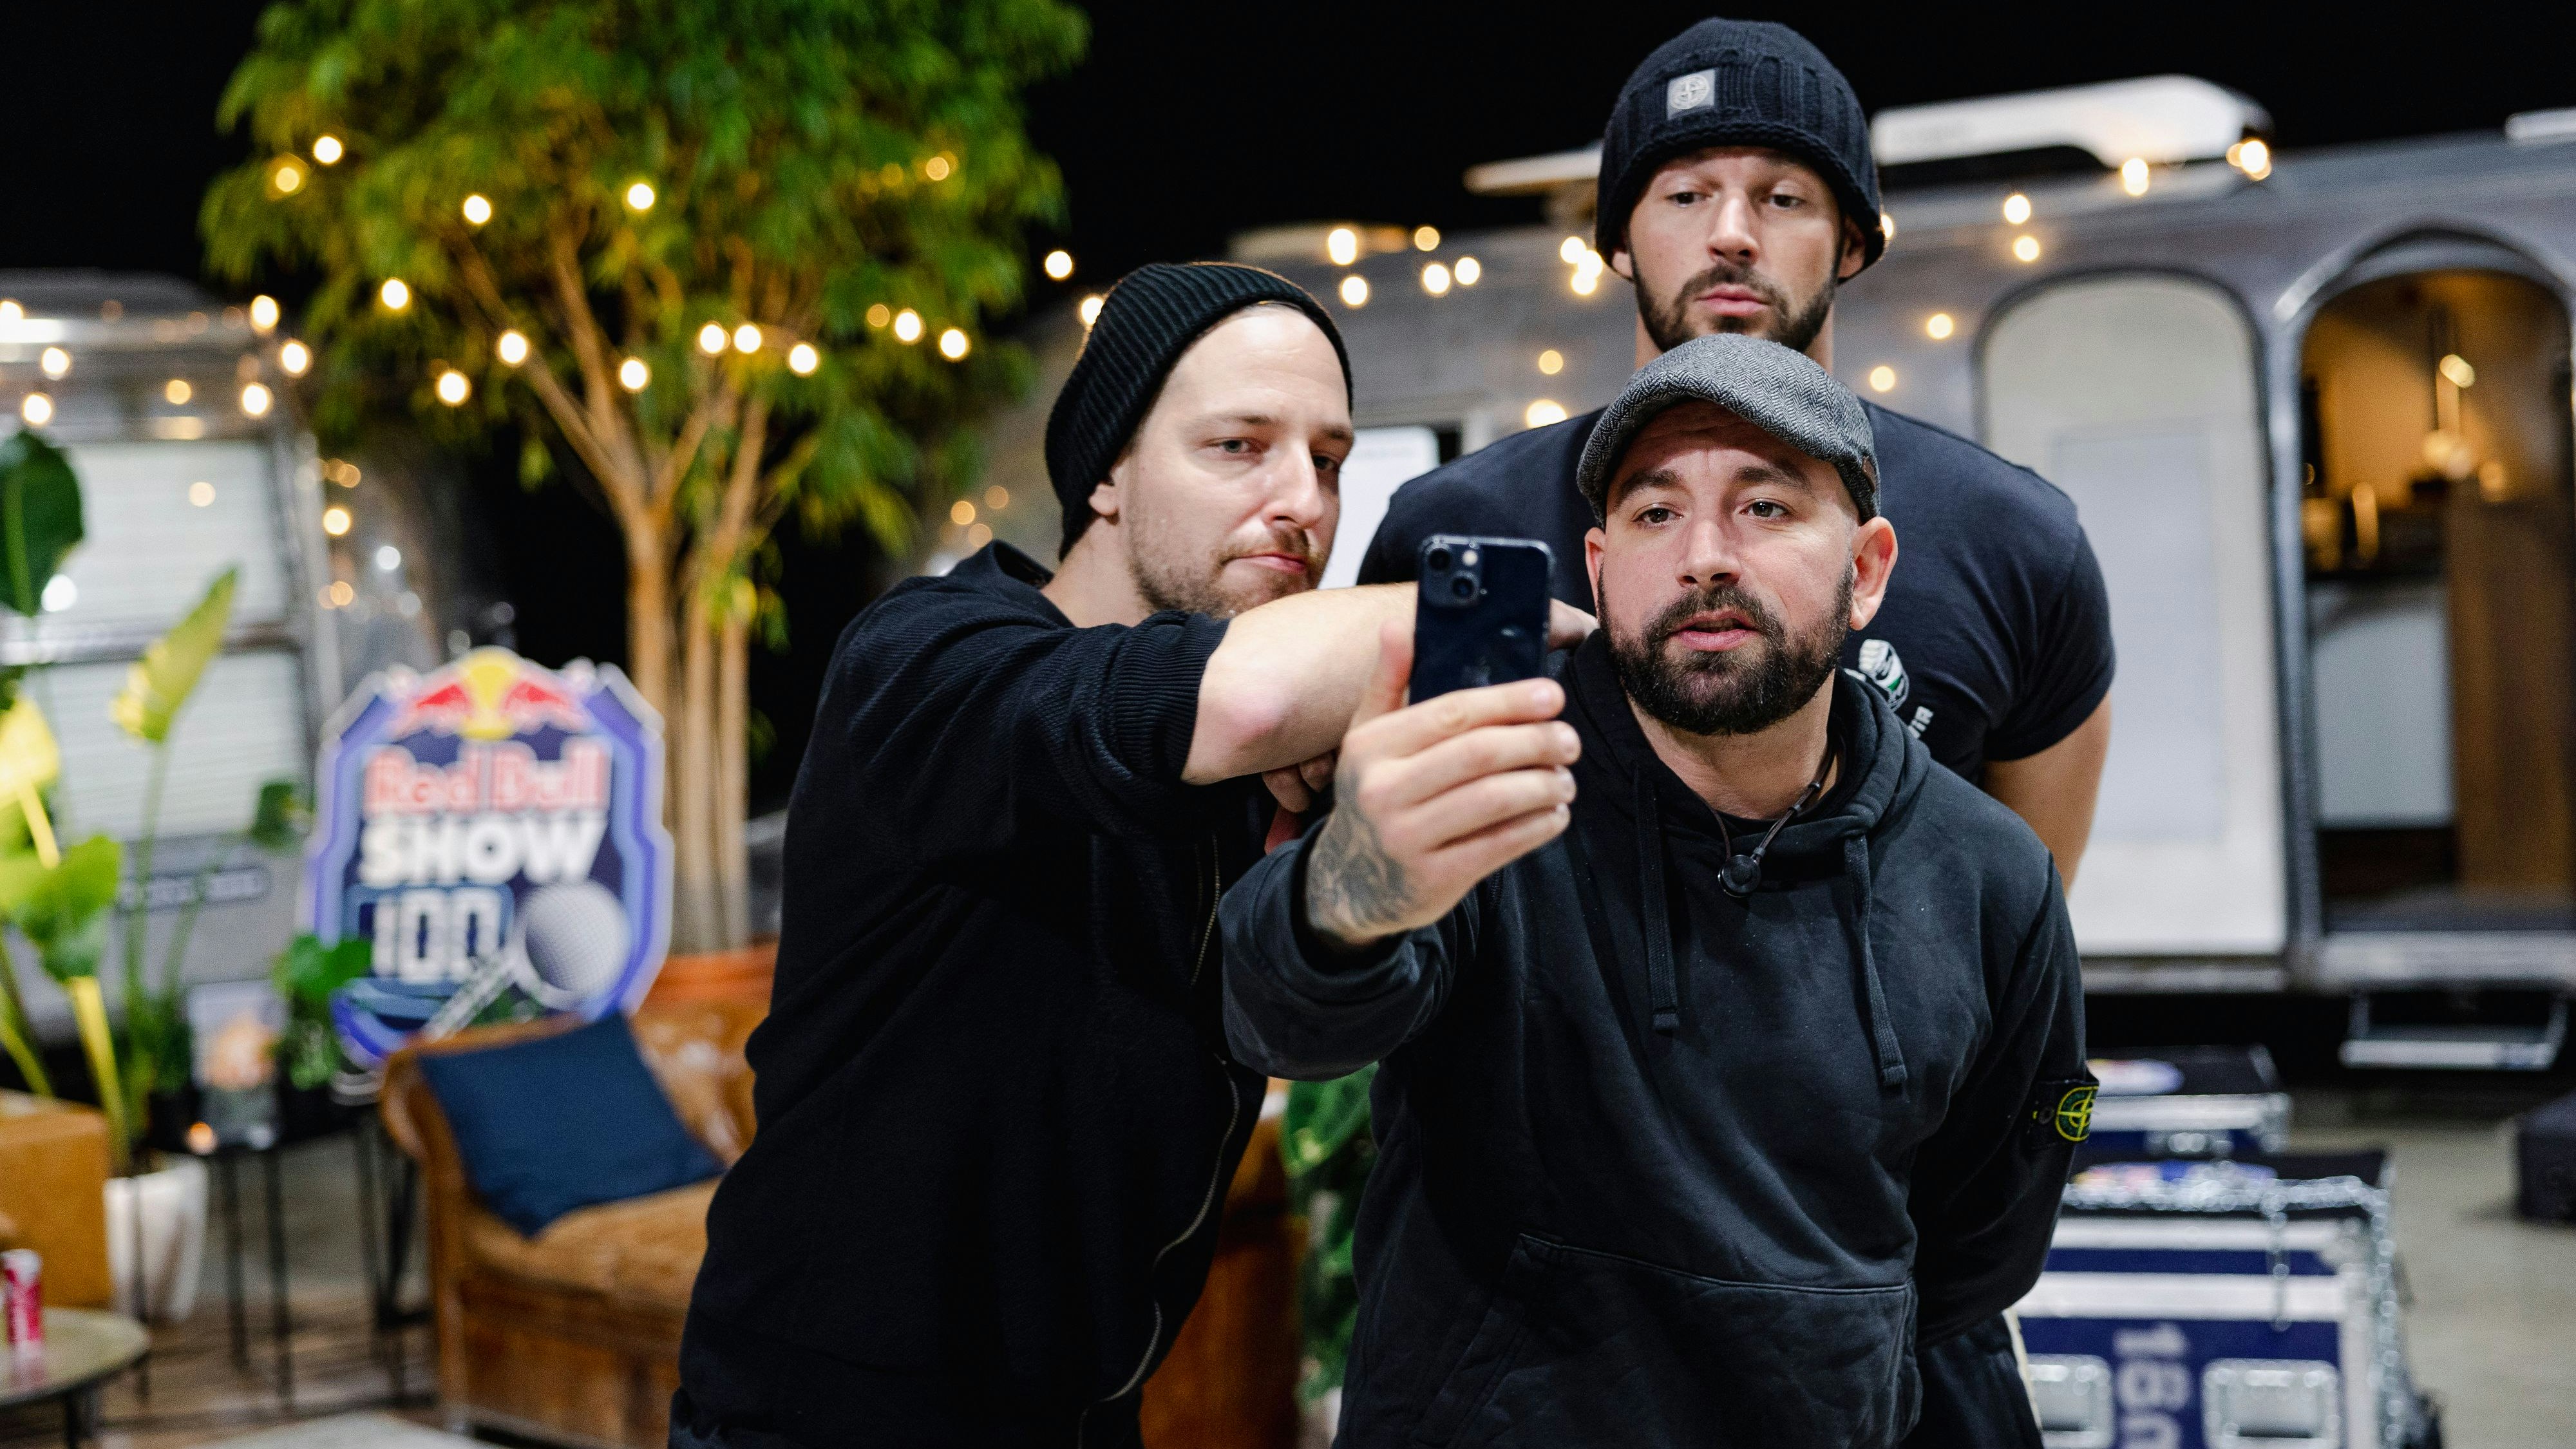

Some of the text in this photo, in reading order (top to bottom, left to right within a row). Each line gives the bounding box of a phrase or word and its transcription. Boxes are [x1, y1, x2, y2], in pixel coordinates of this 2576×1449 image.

[366, 739, 609, 813] Red Bull
[361, 818, 607, 886] SHOW
